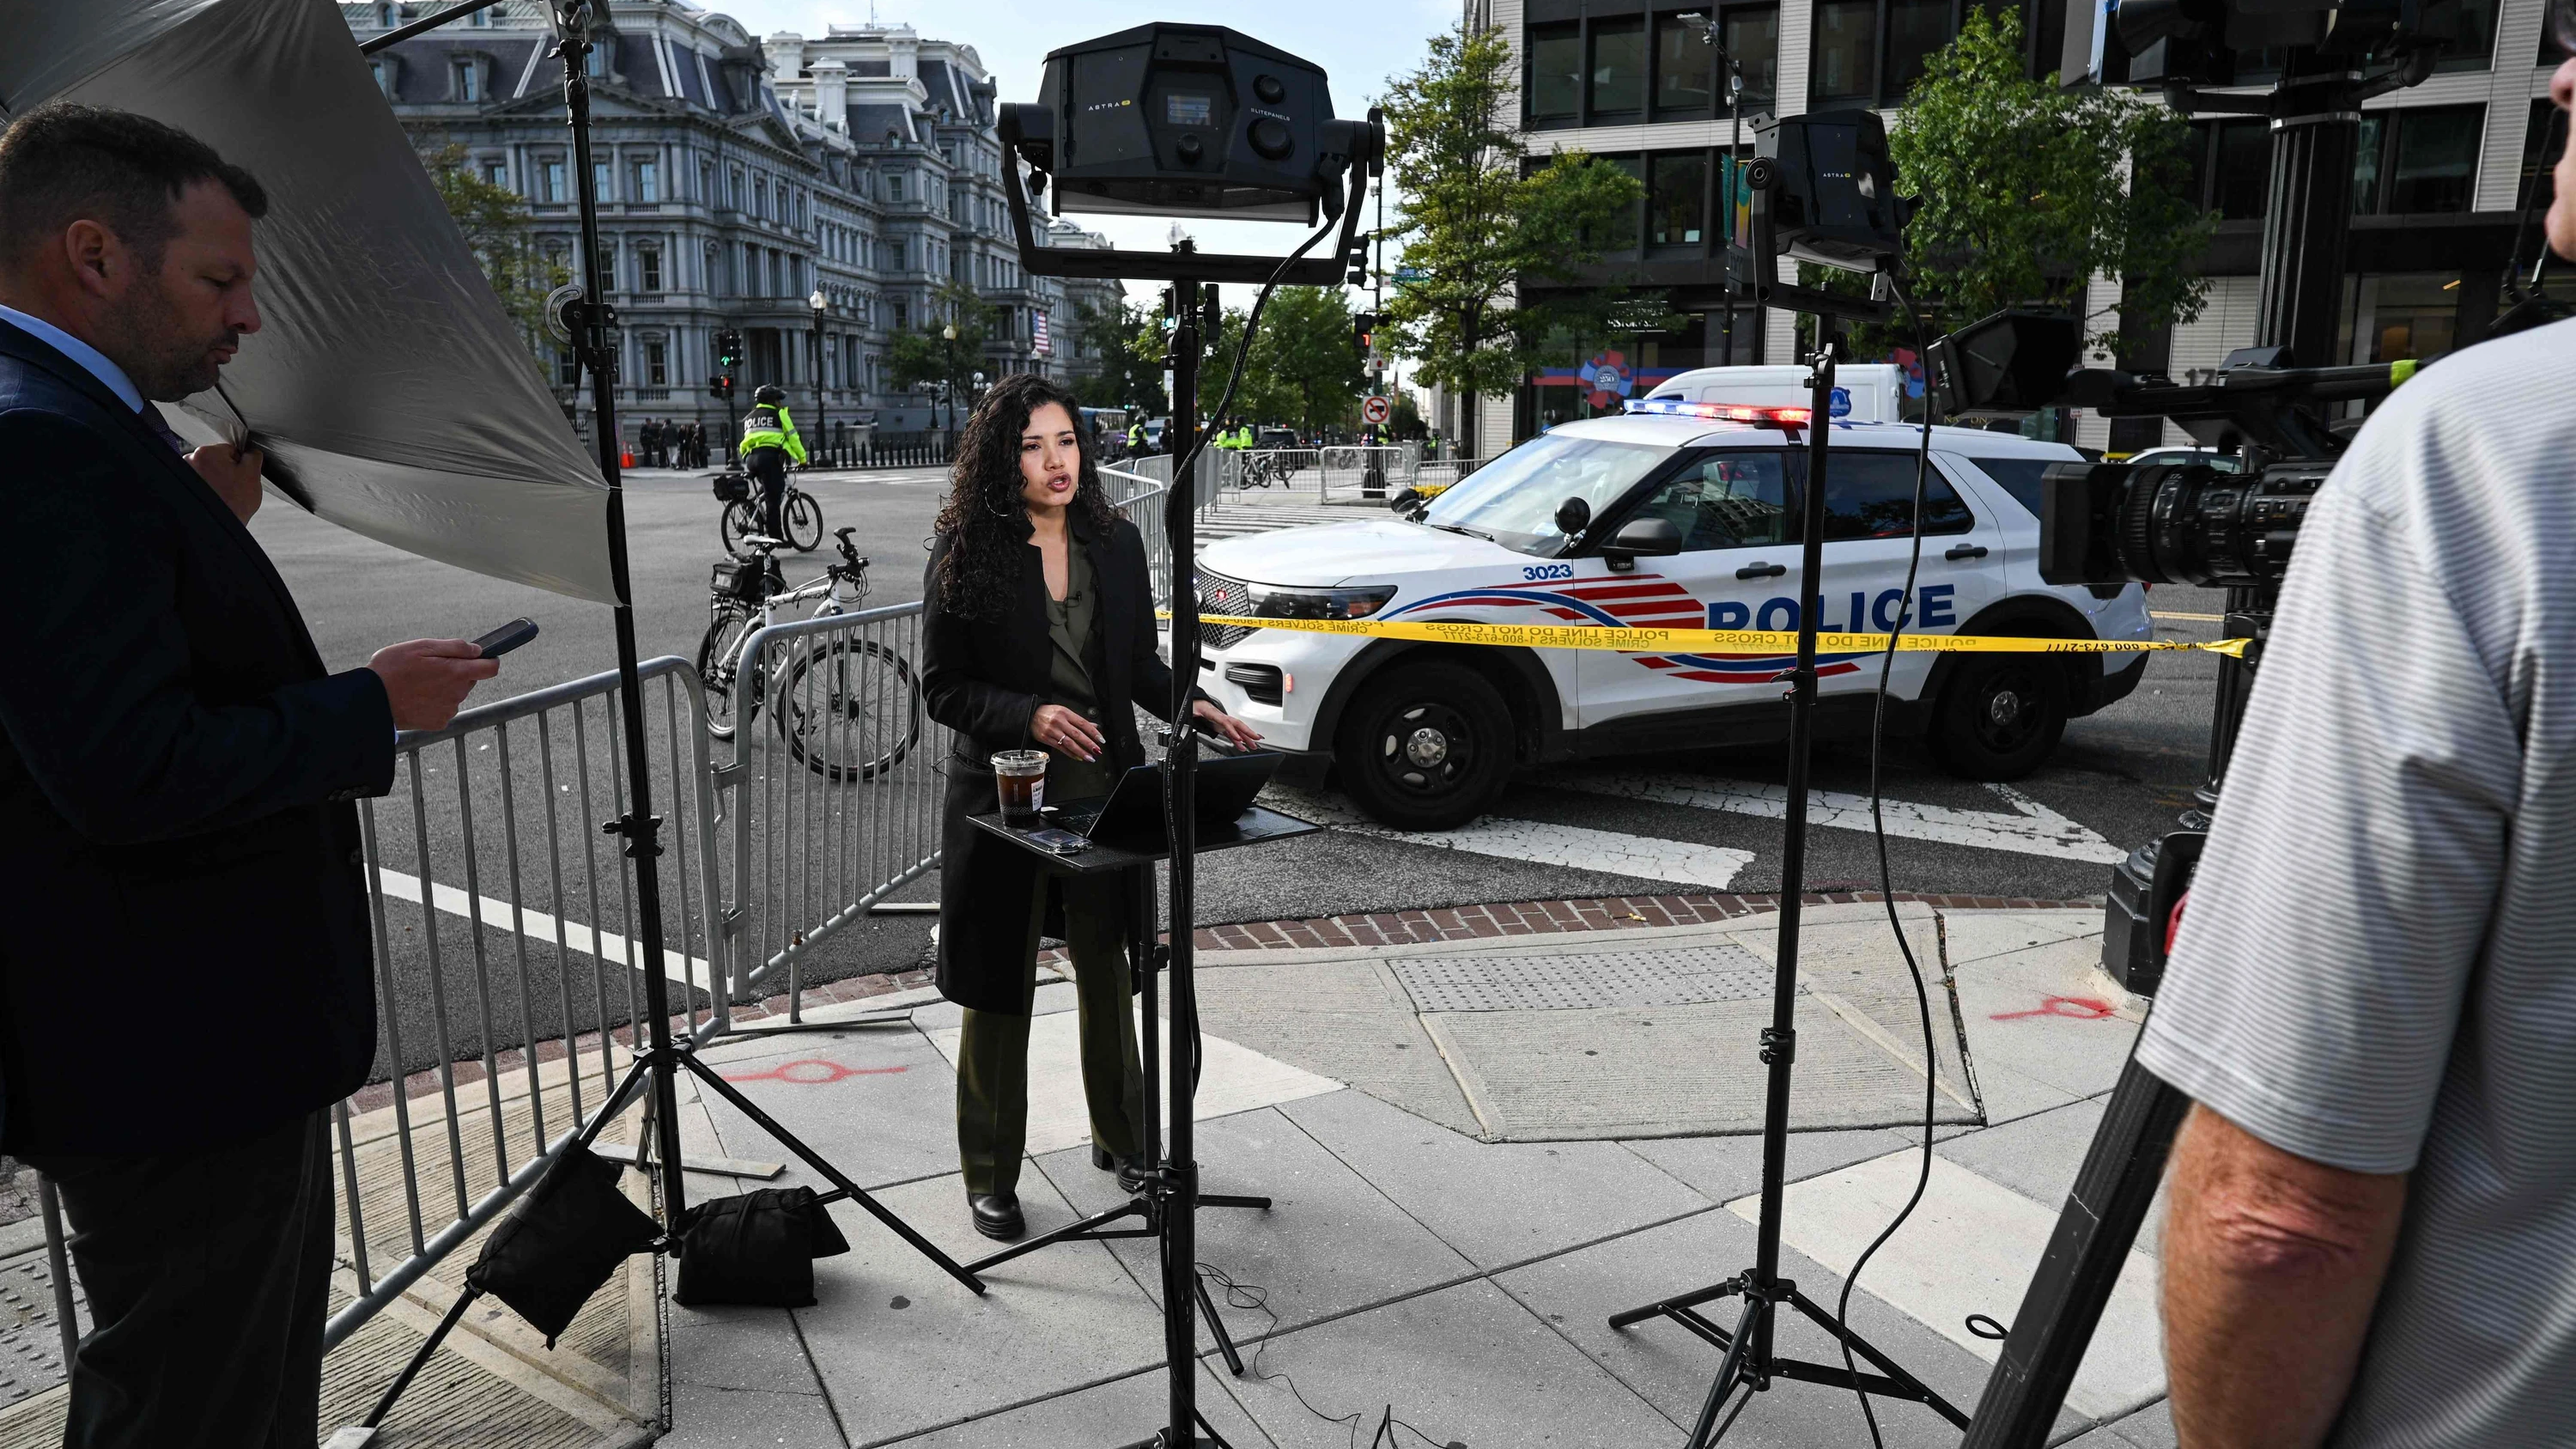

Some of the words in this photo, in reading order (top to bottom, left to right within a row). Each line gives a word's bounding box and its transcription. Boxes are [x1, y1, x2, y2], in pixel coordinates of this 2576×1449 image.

[1088, 101, 1120, 111] ASTRA
[1522, 563, 1572, 581] 3023
[1708, 583, 1957, 633] POLICE
